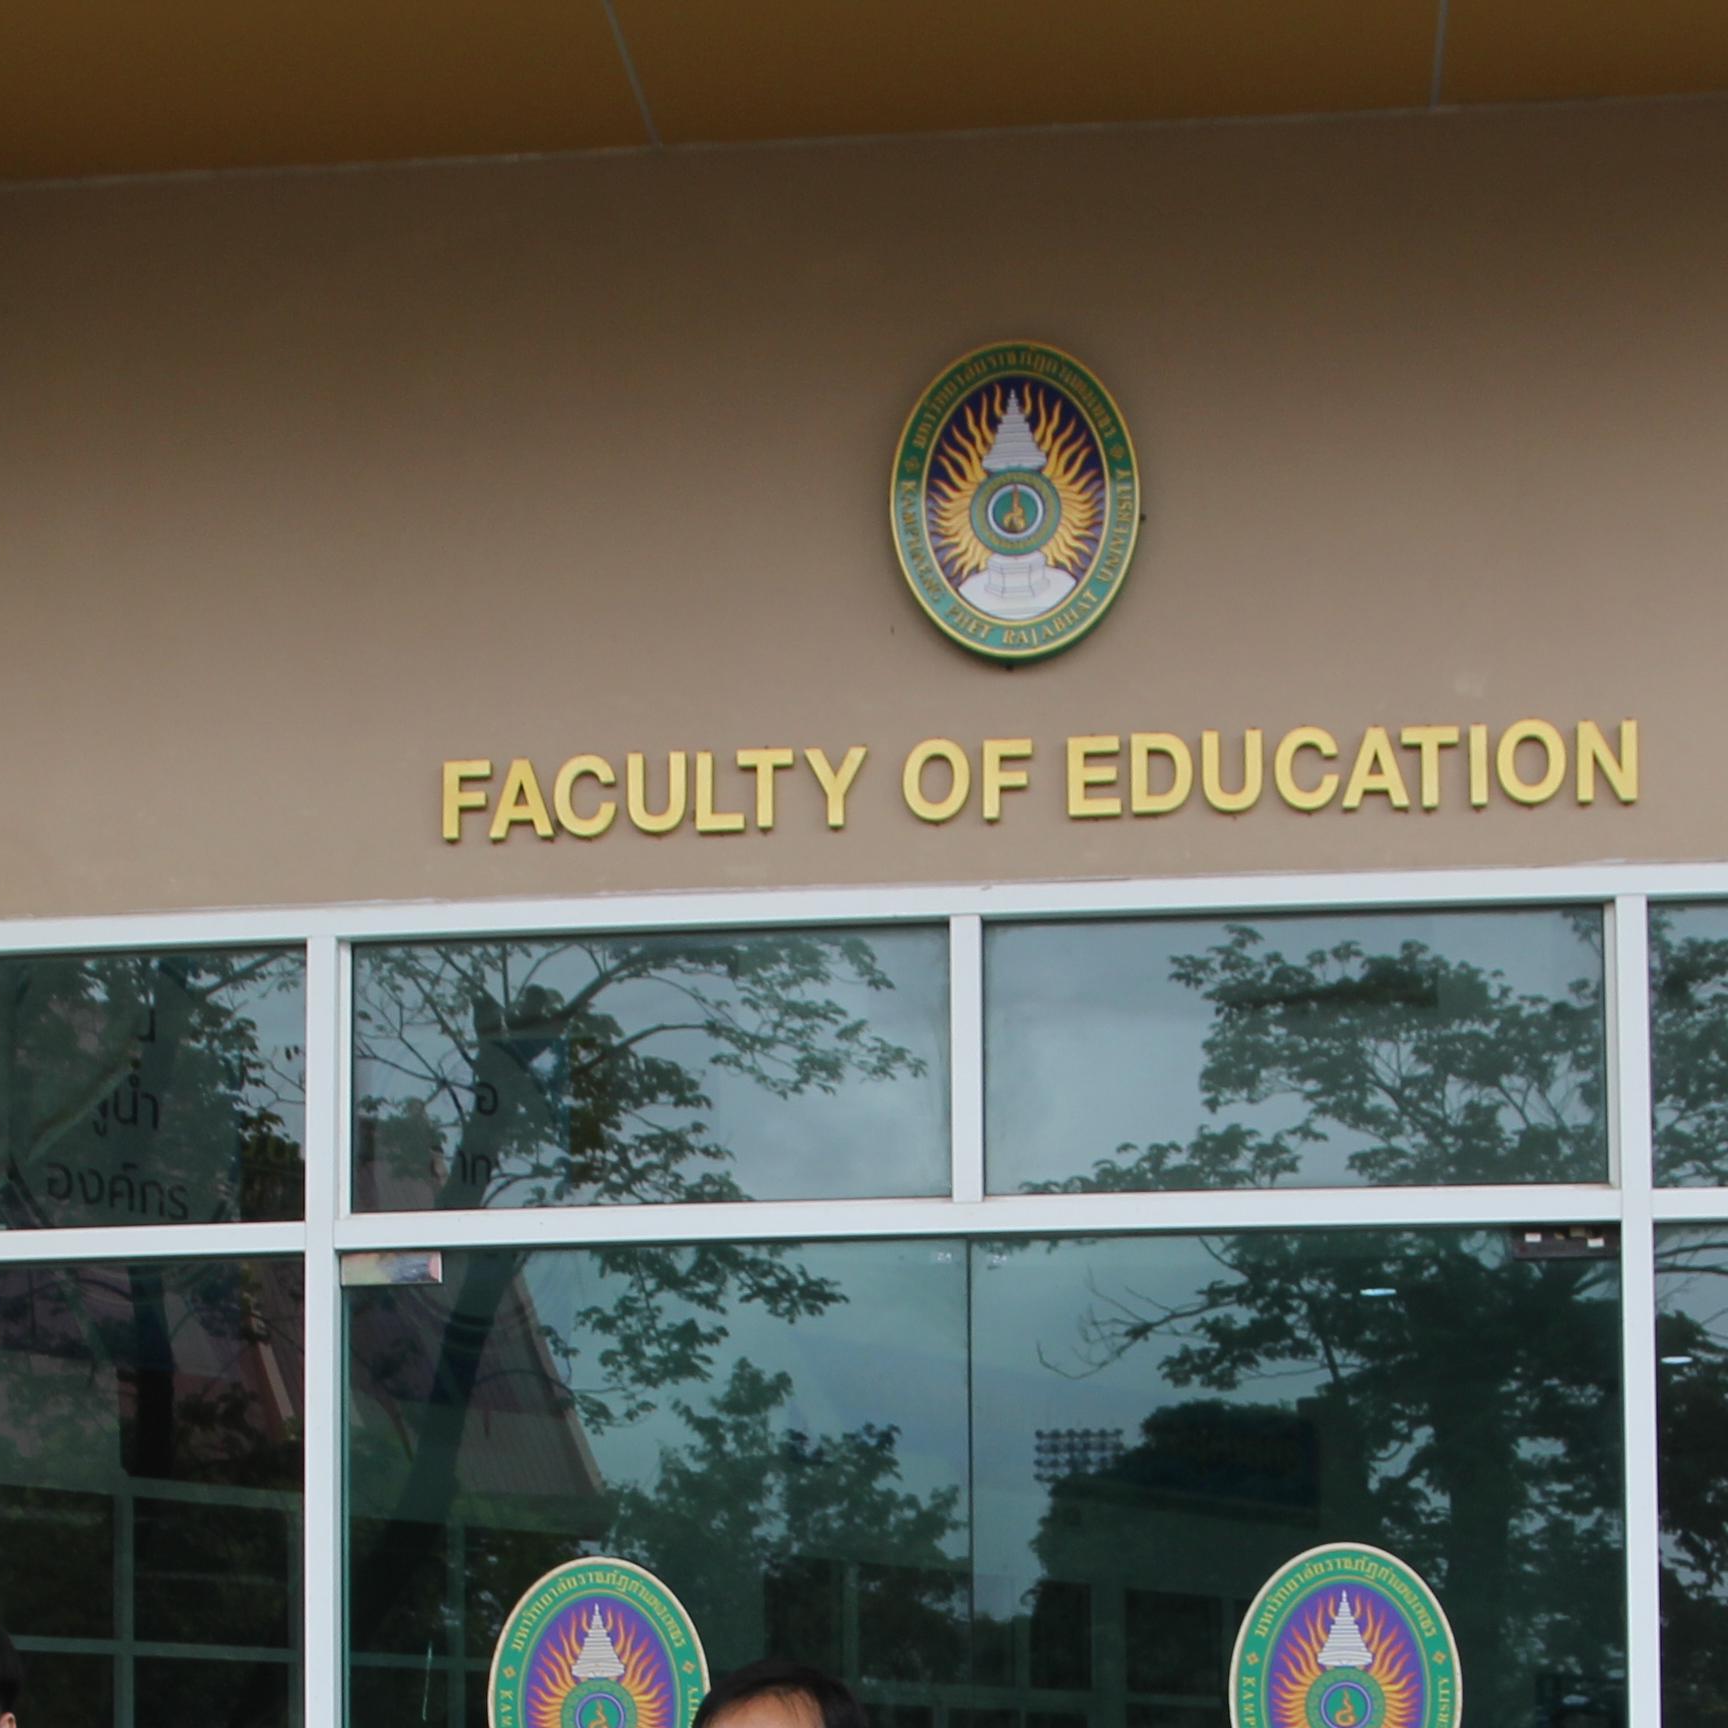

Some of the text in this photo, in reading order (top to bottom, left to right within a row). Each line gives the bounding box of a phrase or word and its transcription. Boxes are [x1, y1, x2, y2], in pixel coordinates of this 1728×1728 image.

[441, 718, 1641, 841] FACULTY OF EDUCATION
